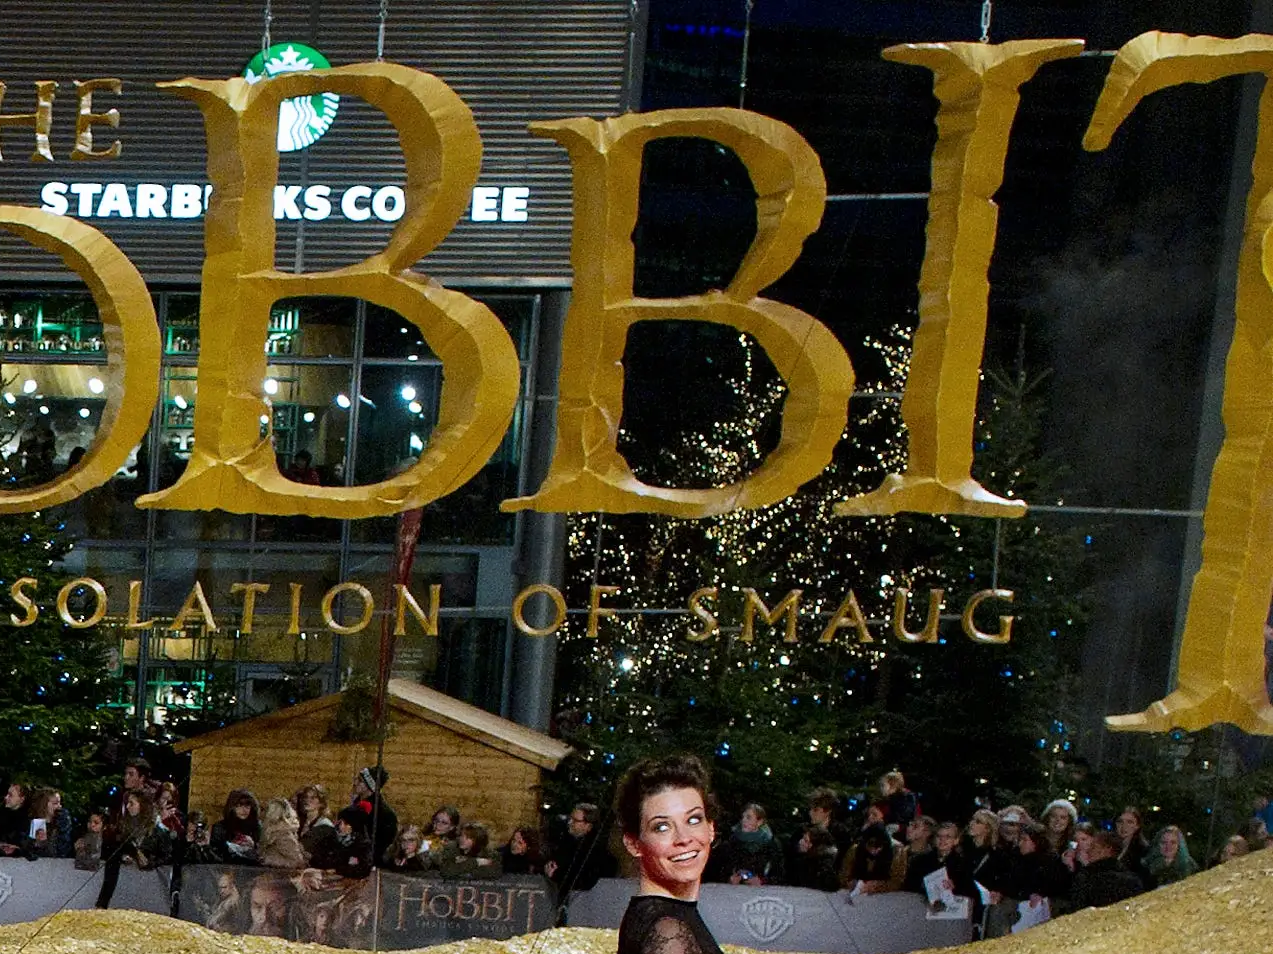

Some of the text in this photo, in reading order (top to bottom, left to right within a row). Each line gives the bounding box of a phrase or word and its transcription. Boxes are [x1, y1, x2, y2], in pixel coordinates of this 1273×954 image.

[40, 182, 530, 223] STARBKS COEE
[512, 583, 622, 638] OF
[685, 586, 1016, 644] SMAUG
